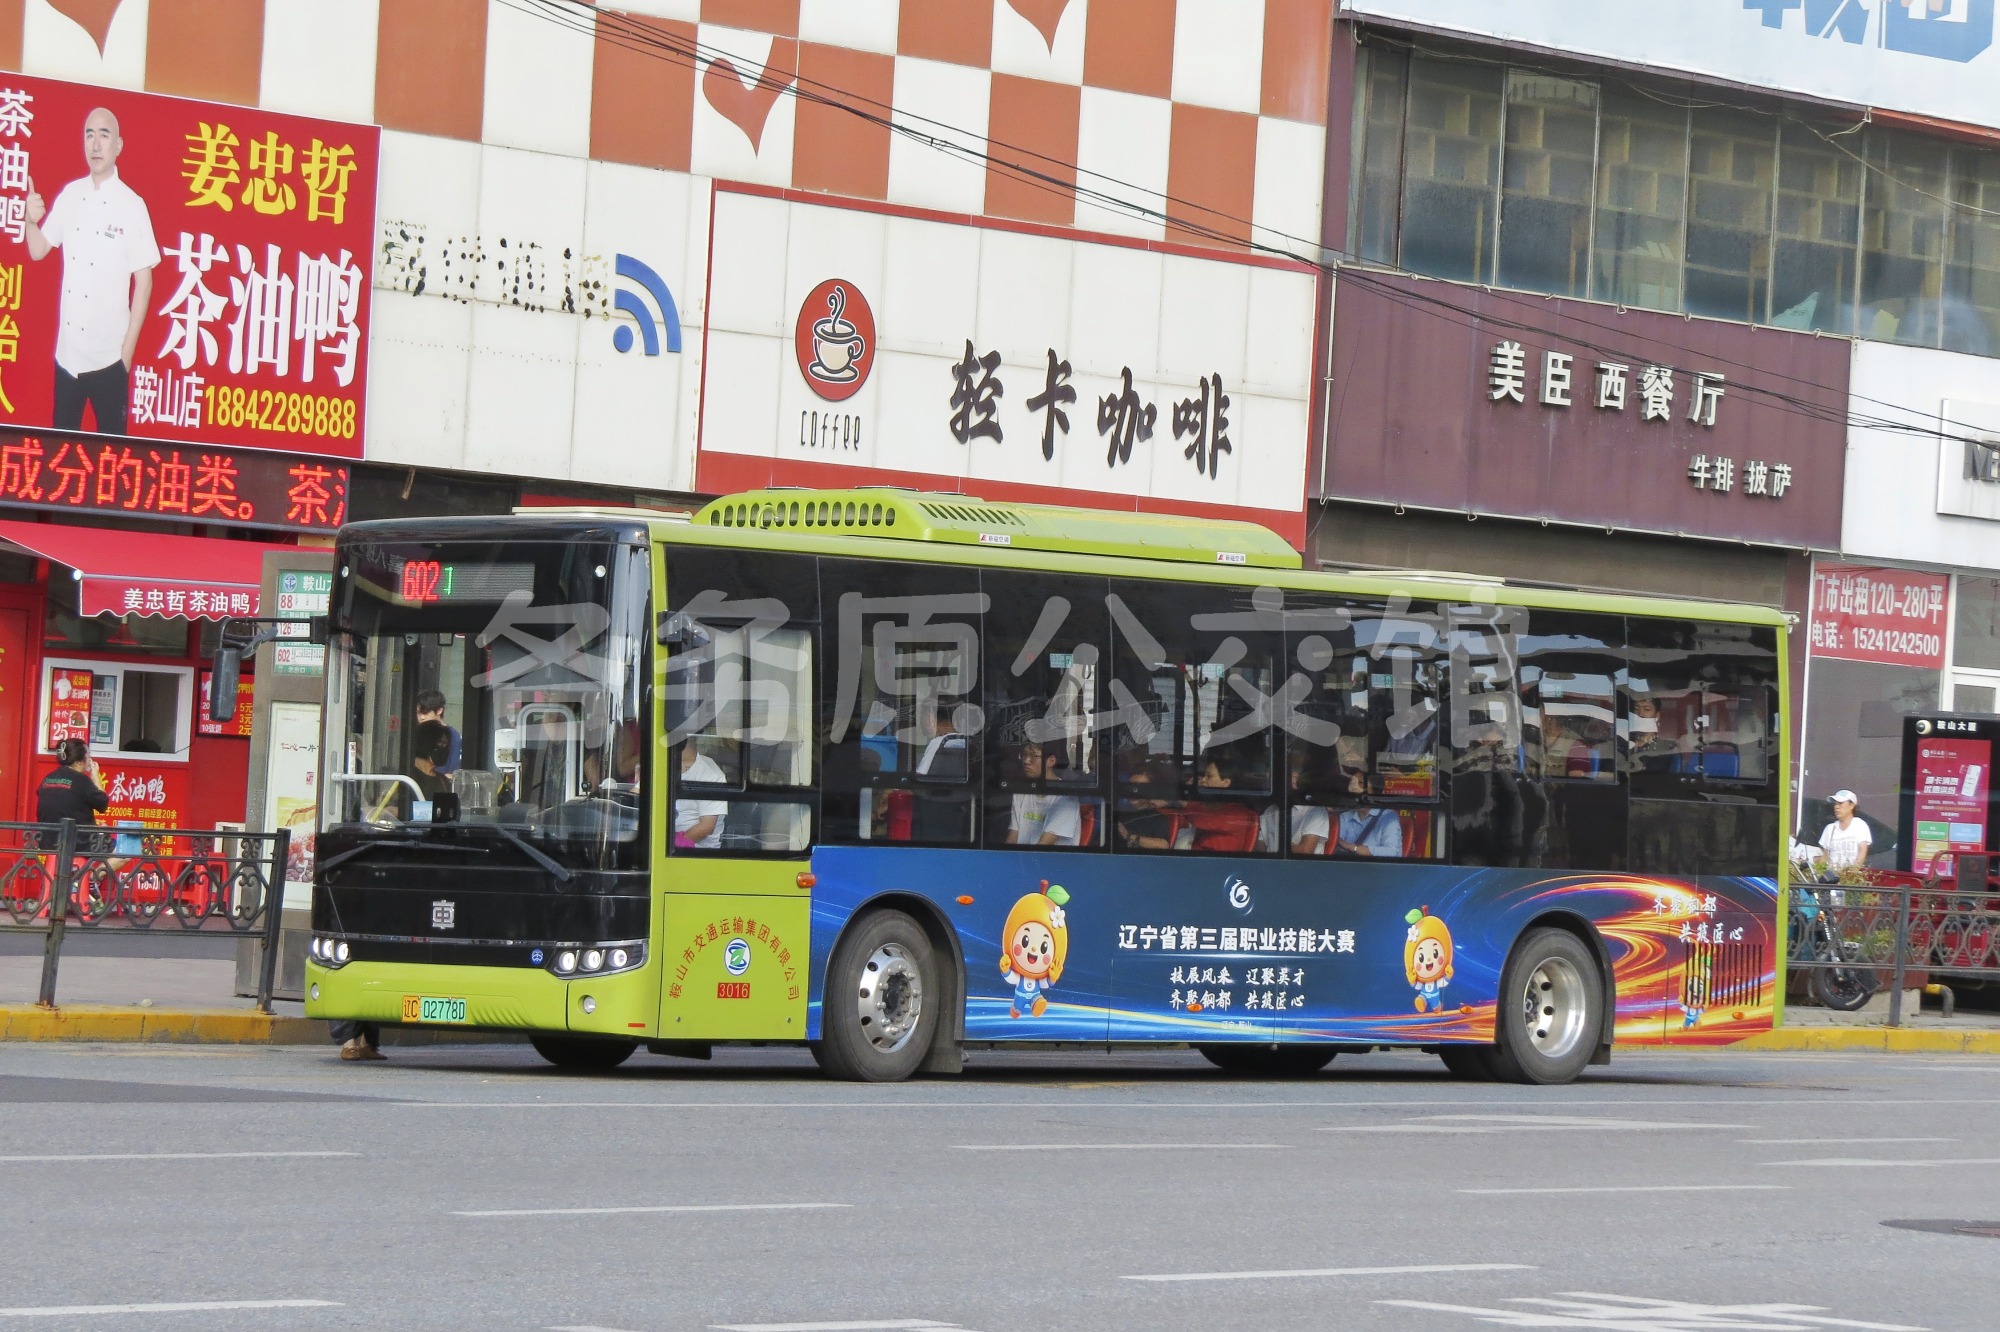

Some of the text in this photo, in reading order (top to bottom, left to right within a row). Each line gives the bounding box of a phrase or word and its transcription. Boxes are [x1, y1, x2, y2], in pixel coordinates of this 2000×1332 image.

[0, 88, 34, 244] 茶油鸭
[181, 122, 358, 224] 姜忠哲
[157, 231, 364, 387] 茶油鸭
[1487, 340, 1726, 427] 美臣西餐厅
[131, 365, 356, 439] 鞍山店 18842289888
[949, 338, 1233, 480] 轻卡咖啡
[0, 437, 254, 521] 成分的油类。
[1688, 454, 1793, 498] 牛排 披萨
[403, 562, 440, 601] 602
[124, 588, 250, 614] 姜忠哲茶油鸭
[280, 594, 293, 609] 88
[1811, 571, 1943, 624] 门市出租120-280平
[280, 622, 292, 635] 126
[277, 649, 291, 663] 602
[239, 713, 253, 724] 3元
[240, 702, 253, 713] 5元
[52, 722, 69, 741] 25
[238, 725, 252, 736] 2元
[109, 771, 166, 804] 茶油鸭
[1653, 894, 1717, 919] 齐聚钢都
[1118, 924, 1356, 953] 辽宁省第三届职业技能大赛
[1678, 921, 1744, 944] 共筑匠心
[669, 916, 800, 1000] 鞍山市交通运输集团有限公司
[1169, 966, 1305, 986] 技展风采 辽聚英才
[718, 983, 749, 998] 3016
[1169, 989, 1305, 1011] 齐聚钢都 共筑匠心
